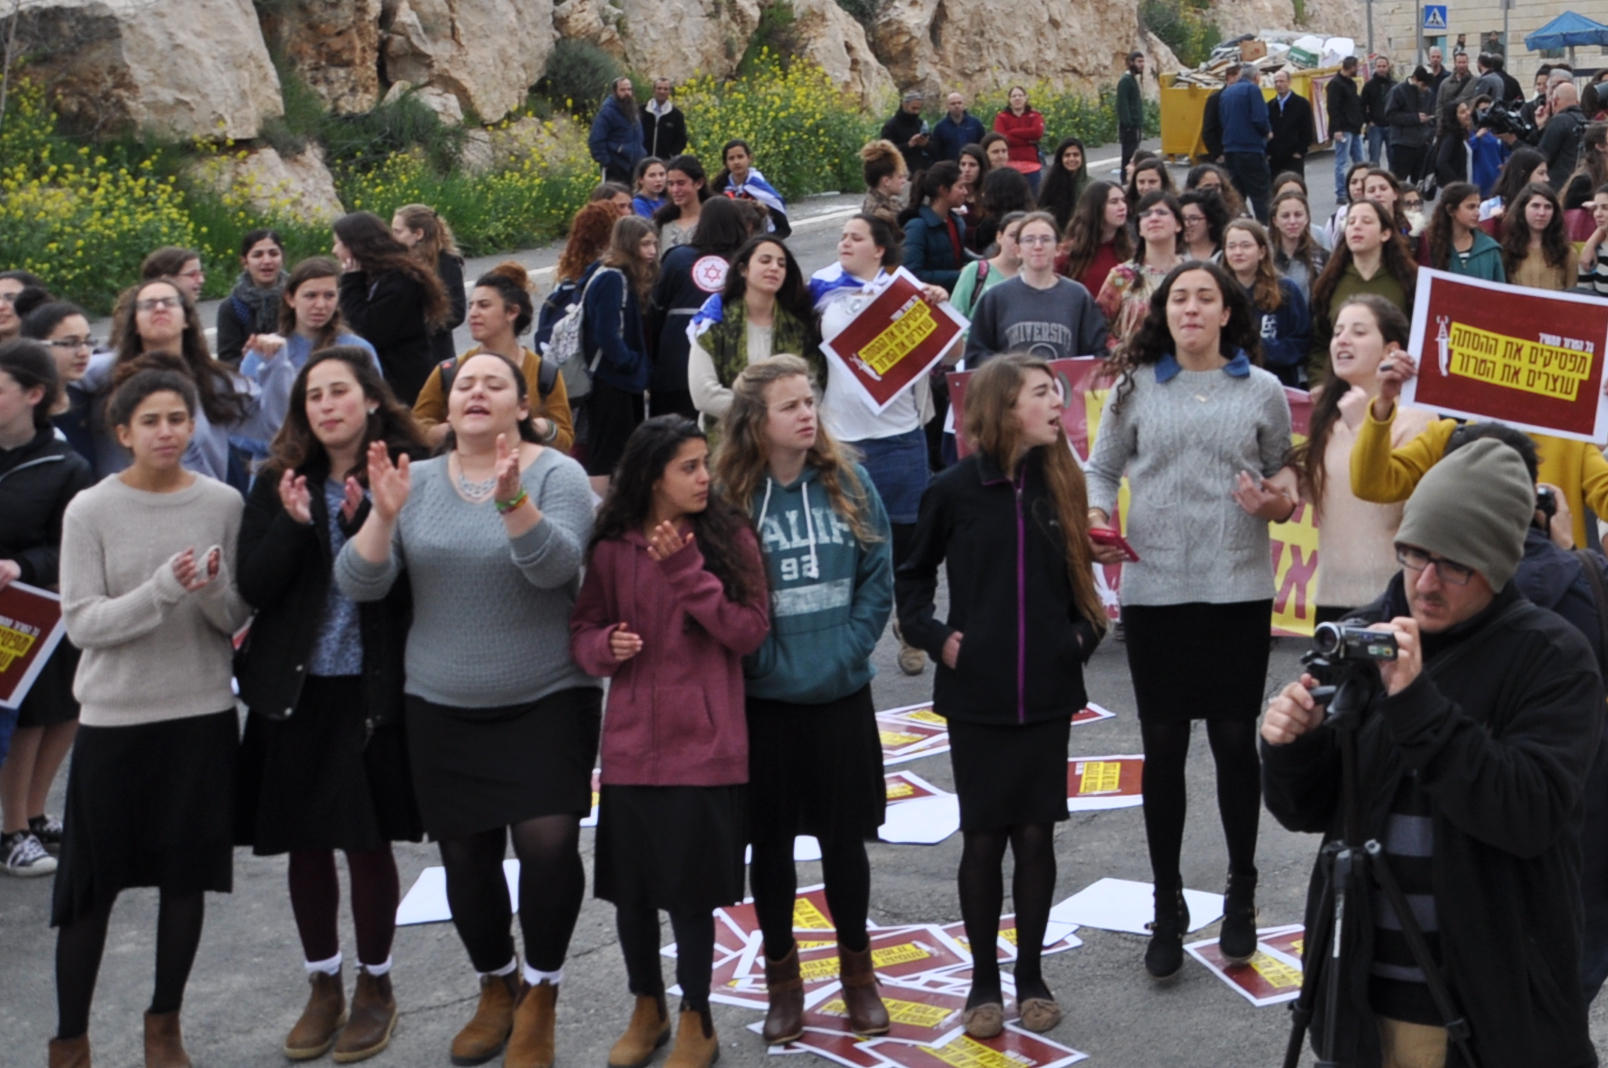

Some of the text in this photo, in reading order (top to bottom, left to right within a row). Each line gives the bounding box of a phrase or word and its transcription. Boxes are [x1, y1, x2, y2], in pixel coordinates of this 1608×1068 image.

[1451, 327, 1588, 375] מפסיקים את ההסתה
[1457, 352, 1575, 397] עוצרים את הטרור
